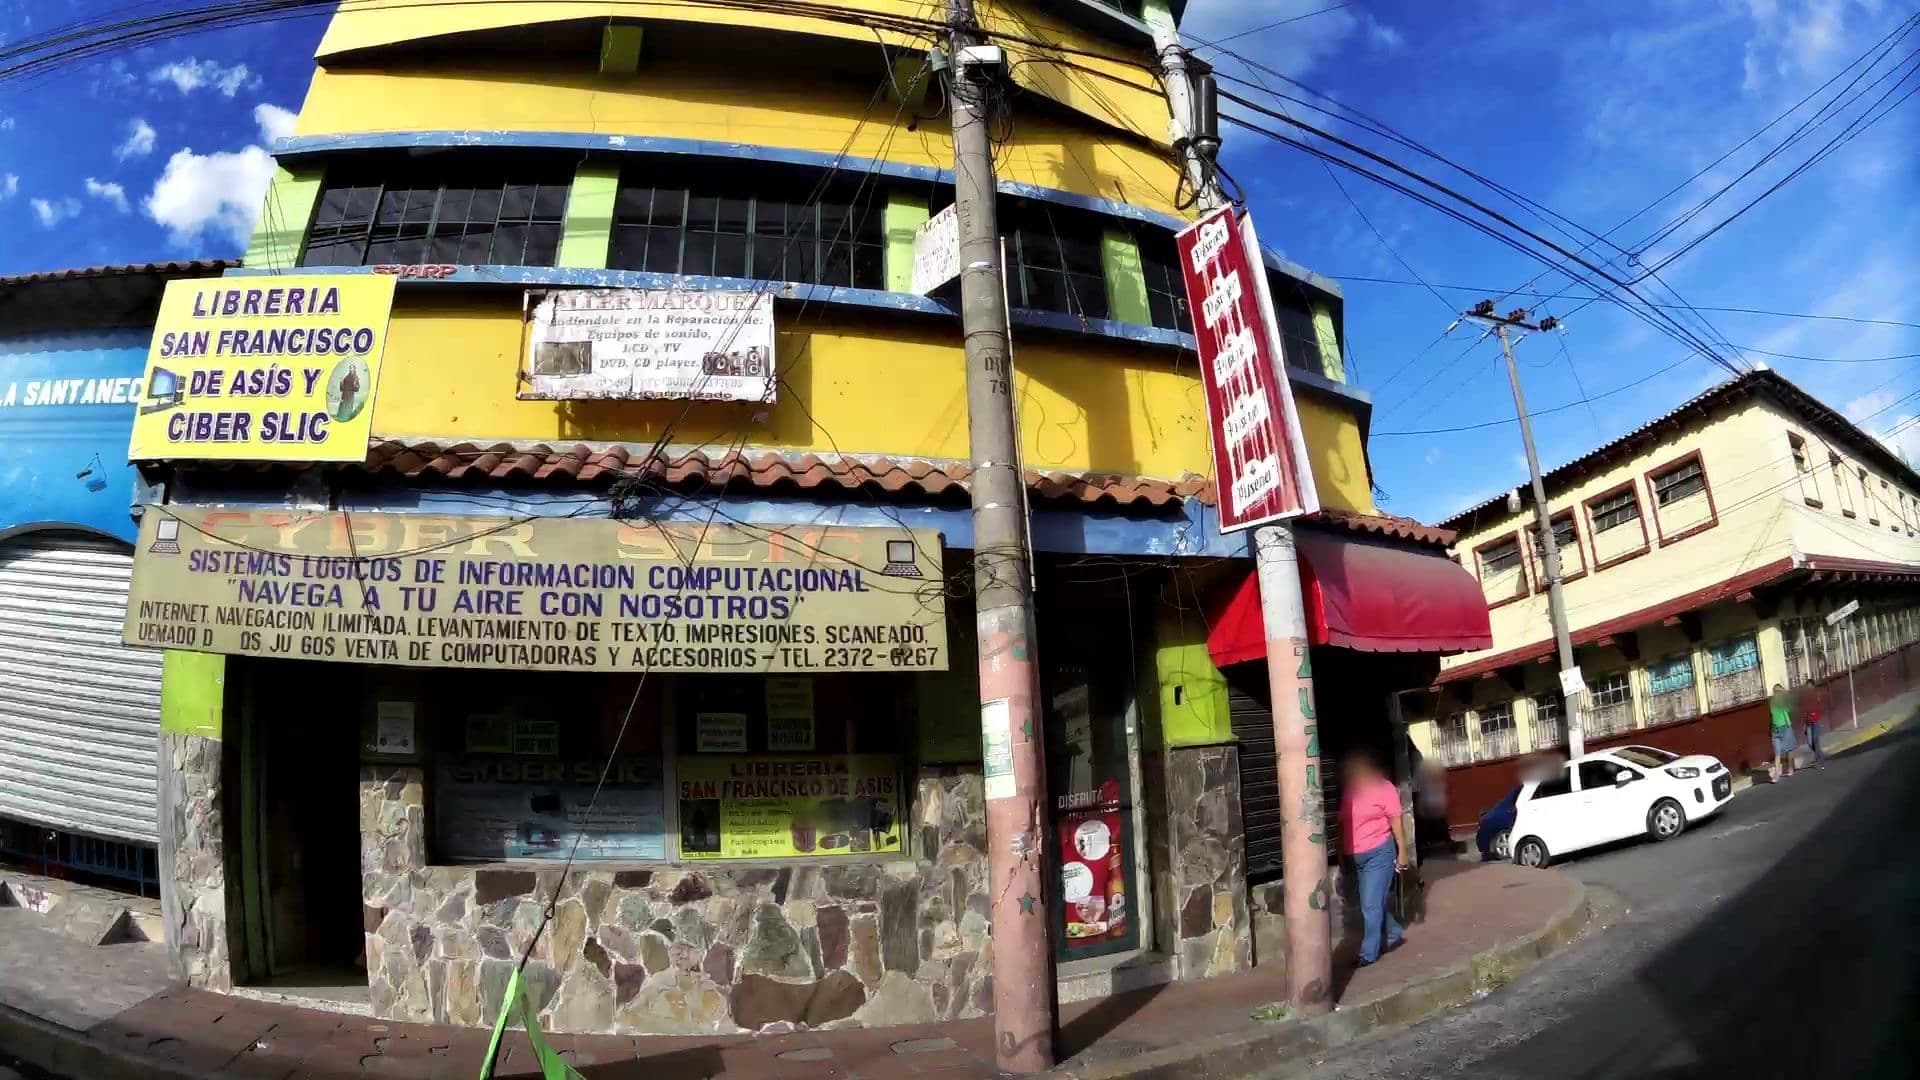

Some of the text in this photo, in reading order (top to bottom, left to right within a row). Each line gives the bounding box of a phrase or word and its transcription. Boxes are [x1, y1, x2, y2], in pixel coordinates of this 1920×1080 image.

[372, 263, 457, 277] SHARP
[193, 287, 339, 317] LIBRERIA
[160, 327, 373, 358] SAN FRANCISCO
[587, 329, 639, 342] Equipos
[645, 328, 661, 339] de
[664, 342, 682, 353] TV
[634, 358, 650, 368] CD
[190, 363, 322, 396] DE ASÍS Y
[167, 411, 330, 443] CIBER SLIC
[200, 512, 538, 557] CYBER
[188, 548, 870, 593] SISTEMAS LOGICOS DE INFORMACION COMPUTACIONAL
[228, 579, 805, 620] "NAVEGA A TU AIRE CON NOSOTROS"
[215, 605, 316, 633] NAVEGACION
[417, 617, 567, 642] LEVANTAMIENTO
[576, 621, 601, 642] DE
[344, 637, 400, 661] VENTA
[408, 641, 432, 662] DE
[442, 642, 597, 666] COMPUTADORAS
[608, 645, 621, 667] Y
[631, 647, 757, 668] ACCESORIOS
[782, 647, 819, 668] TEL.
[730, 760, 848, 778] LIBRERIA
[680, 780, 716, 799] SAN
[721, 779, 823, 799] FRANCISCO
